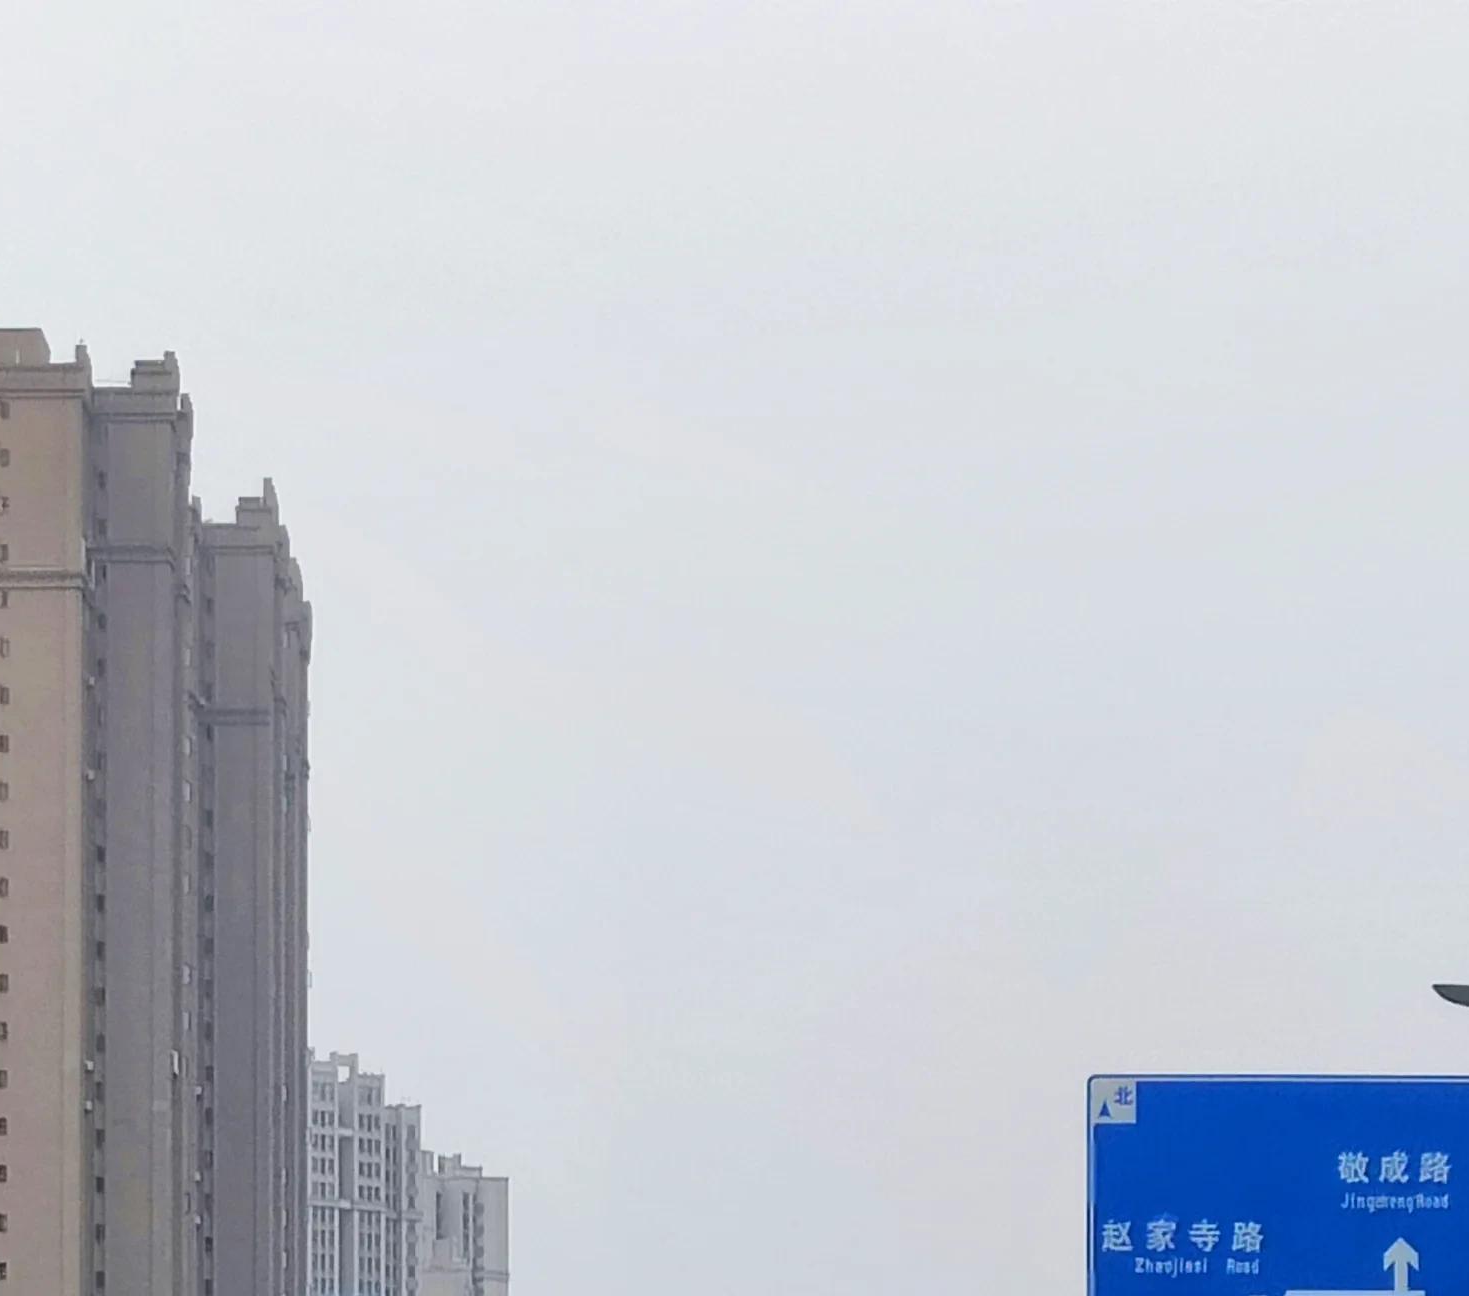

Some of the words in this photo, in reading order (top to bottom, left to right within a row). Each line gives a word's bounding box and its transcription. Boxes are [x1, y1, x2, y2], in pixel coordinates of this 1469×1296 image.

[1113, 1085, 1133, 1106] 北
[1338, 1150, 1452, 1184] 敬成路
[1101, 1218, 1265, 1253] 赵家寺路
[1226, 1258, 1260, 1275] Road
